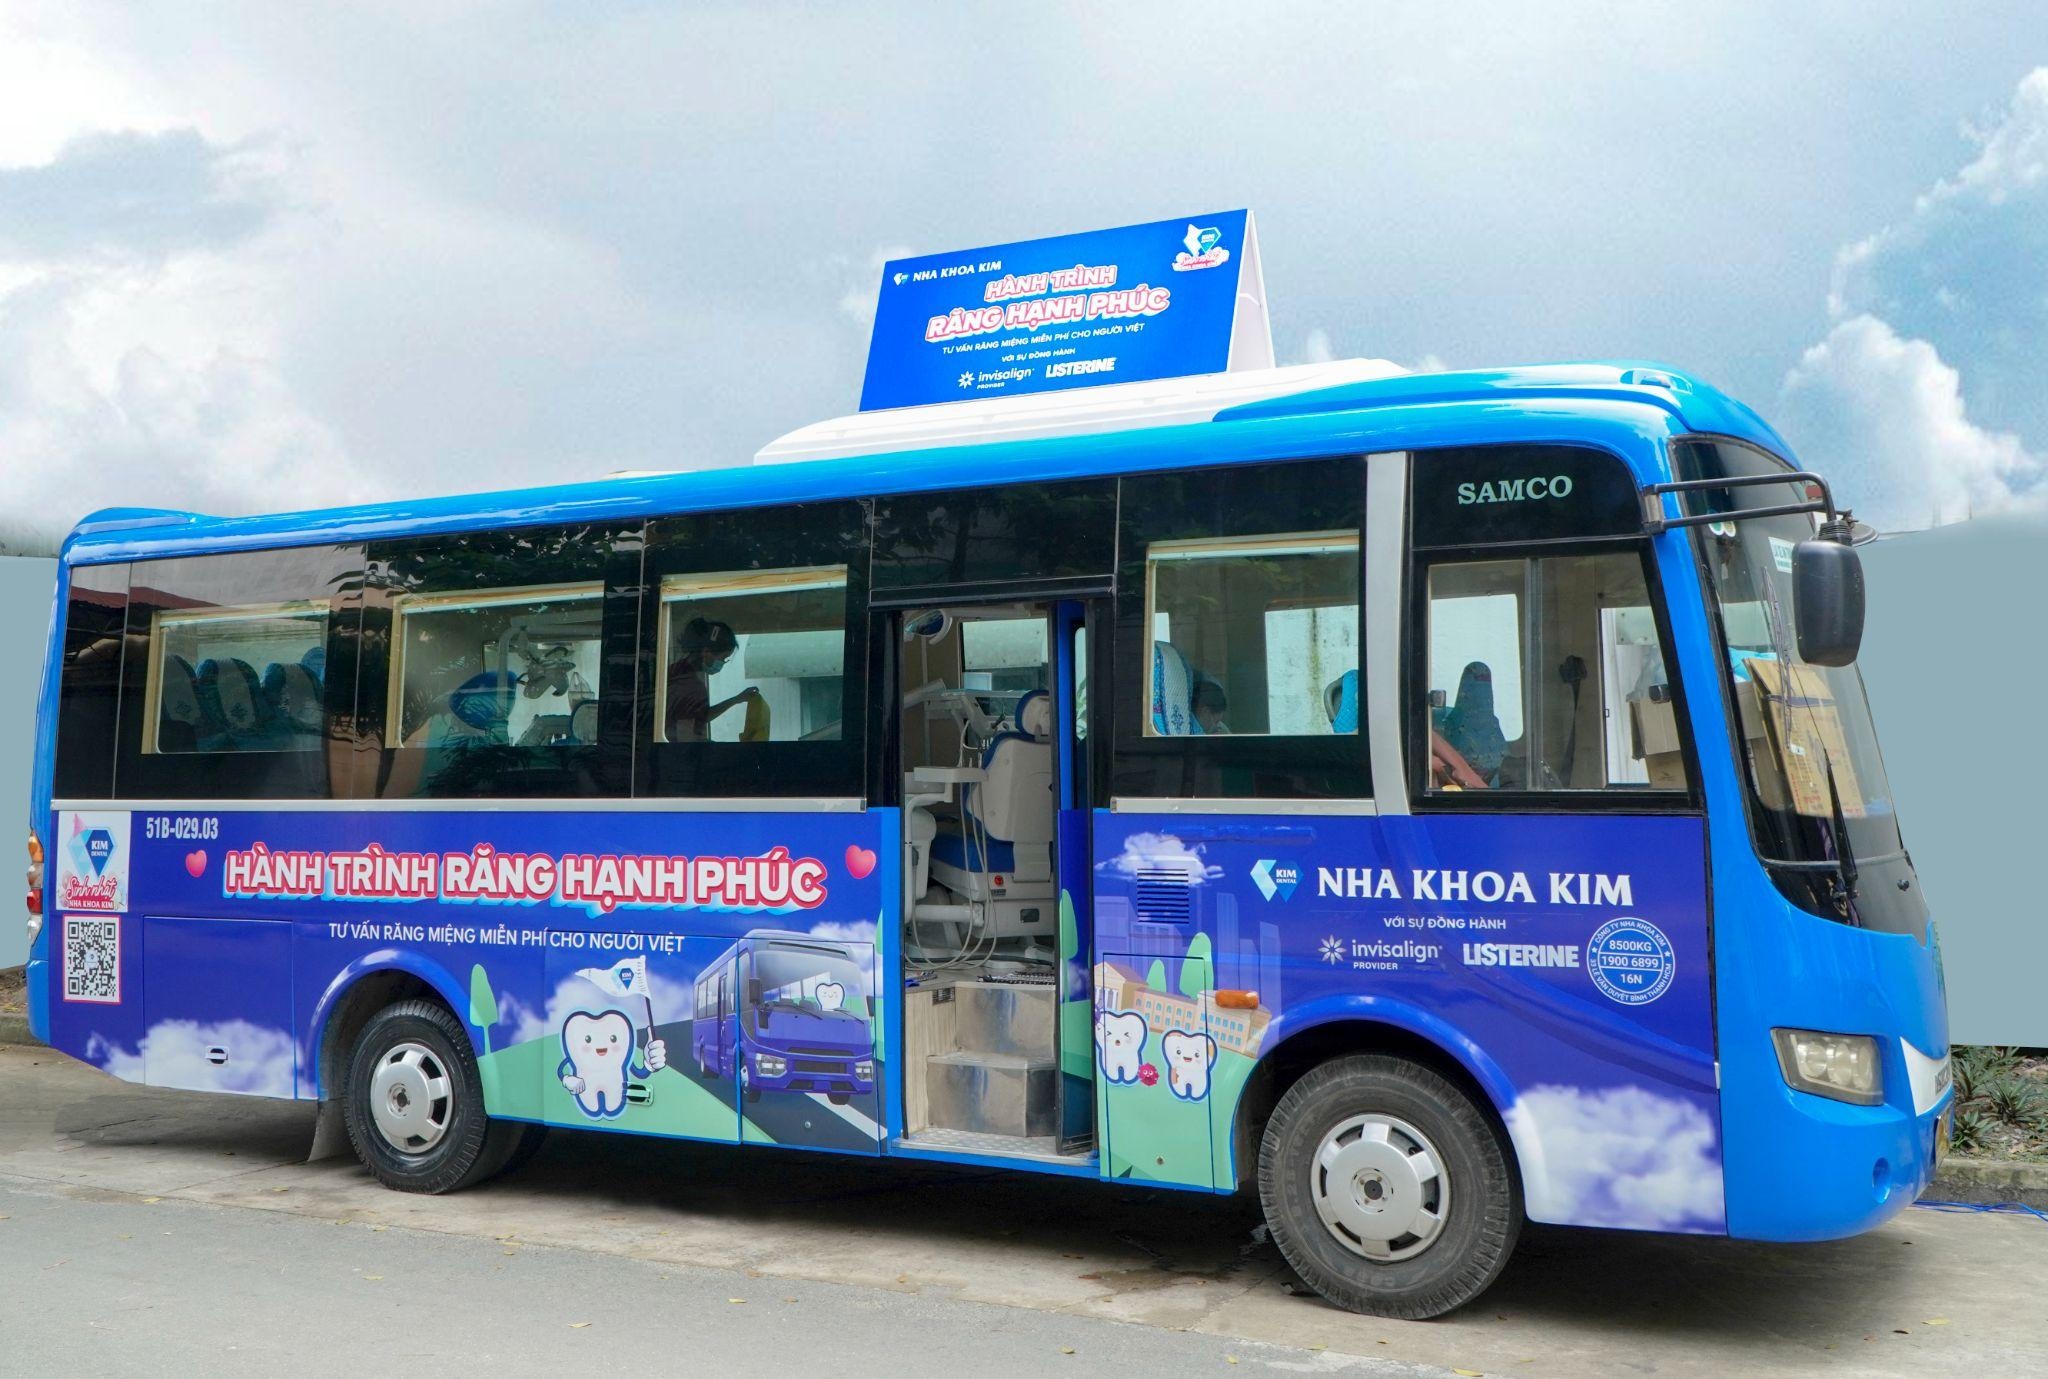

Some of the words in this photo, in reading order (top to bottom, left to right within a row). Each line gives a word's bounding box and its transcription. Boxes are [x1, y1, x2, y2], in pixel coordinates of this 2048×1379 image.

[913, 271, 938, 281] NHA
[940, 265, 975, 277] KHOA
[978, 261, 1002, 272] KIM
[985, 275, 1049, 300] HÀNH
[1051, 266, 1116, 290] TRÌNH
[926, 309, 1003, 339] RĂNG
[1005, 297, 1085, 329] HẠNH
[1088, 285, 1169, 317] PHÚC
[1054, 331, 1070, 341] PHÍ
[1071, 330, 1091, 339] CHO
[1125, 323, 1145, 333] VIỆT
[979, 368, 1032, 382] invisalign
[1046, 357, 1117, 378] LISTERINE
[1457, 476, 1573, 505] SAMCO
[146, 817, 219, 839] 51B-029.03
[92, 841, 108, 849] KIM
[227, 844, 324, 891] HÀNH
[330, 845, 436, 894] TRÌNH
[445, 845, 556, 897] RĂNG
[564, 857, 686, 909] HẠNH
[696, 849, 825, 905] PHÚC
[1276, 869, 1297, 878] KIM
[67, 876, 92, 899] Sinh
[91, 876, 117, 900] nhật
[1317, 867, 1402, 899] NHA
[1412, 869, 1537, 903] KHOA
[1549, 873, 1634, 906] KIM
[69, 900, 82, 908] NHA
[1383, 915, 1405, 928] VỚI
[1409, 917, 1425, 931] SỰ
[1428, 916, 1466, 929] ĐỒNG
[1469, 916, 1506, 930] HÀNH
[329, 922, 348, 938] TƯ
[351, 920, 380, 939] VẤN
[384, 923, 424, 941] RĂNG
[429, 924, 476, 946] MIỆNG
[480, 924, 517, 946] MIỄN
[522, 927, 548, 946] PHÍ
[550, 931, 585, 948] CHO
[590, 930, 644, 950] NGƯỜI
[648, 932, 685, 955] VIỆT
[1595, 927, 1611, 943] CÔNG
[1636, 922, 1655, 936] KHOA
[1655, 934, 1667, 947] KIM
[1352, 939, 1439, 962] invisalign
[1463, 943, 1580, 968] LISTERINE
[1609, 940, 1652, 952] 8500KG
[1353, 962, 1398, 970] PROVIDER
[1601, 956, 1629, 966] 1900
[1631, 957, 1659, 967] 6899
[1620, 974, 1643, 984] 16N
